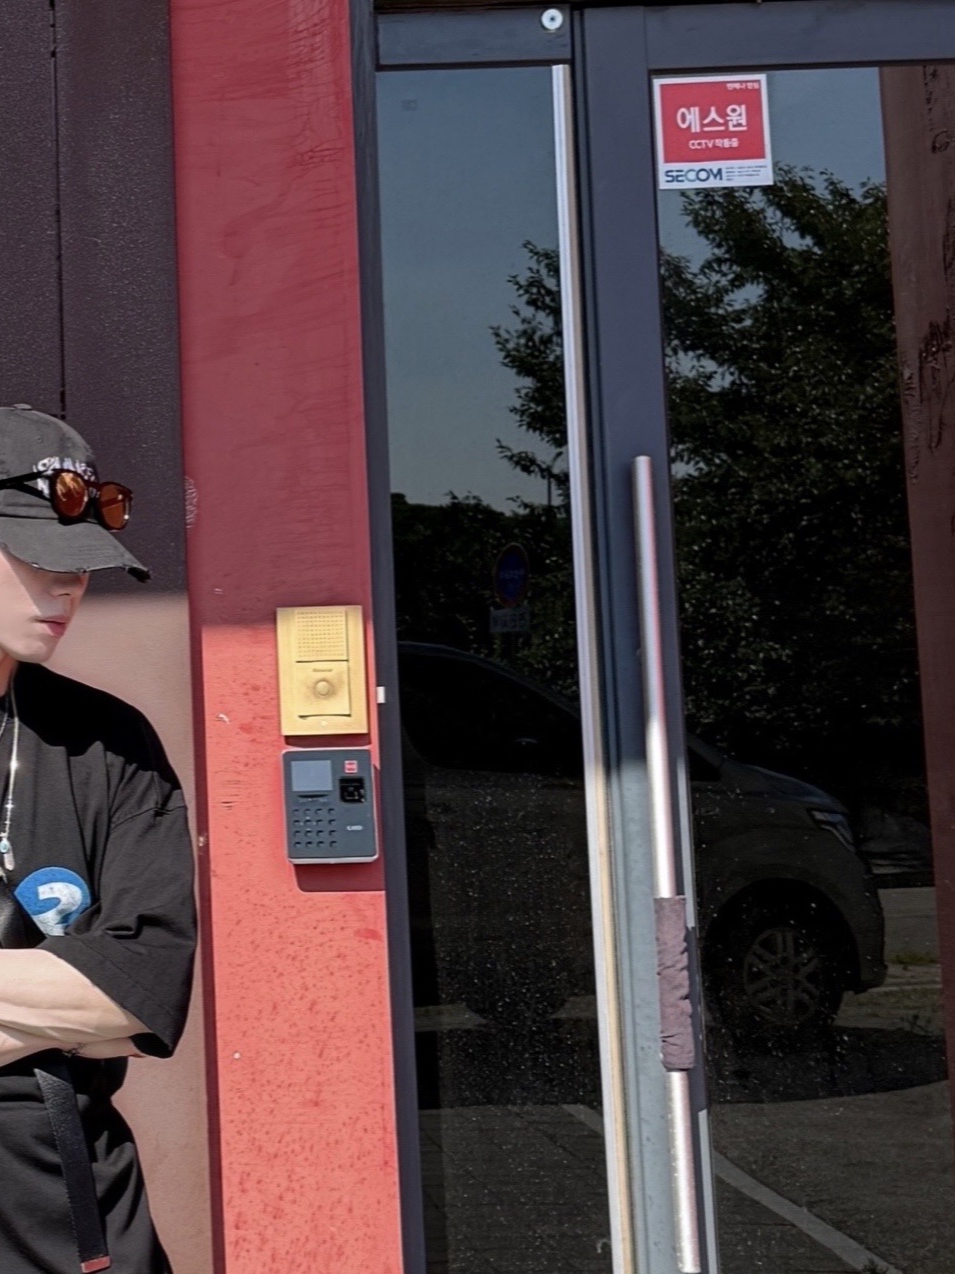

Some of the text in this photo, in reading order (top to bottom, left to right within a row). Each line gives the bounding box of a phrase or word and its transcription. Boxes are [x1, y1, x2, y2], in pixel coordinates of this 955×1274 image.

[676, 104, 748, 133] 에스원
[688, 137, 739, 149] CCTV 작동중
[664, 167, 723, 183] SECOM
